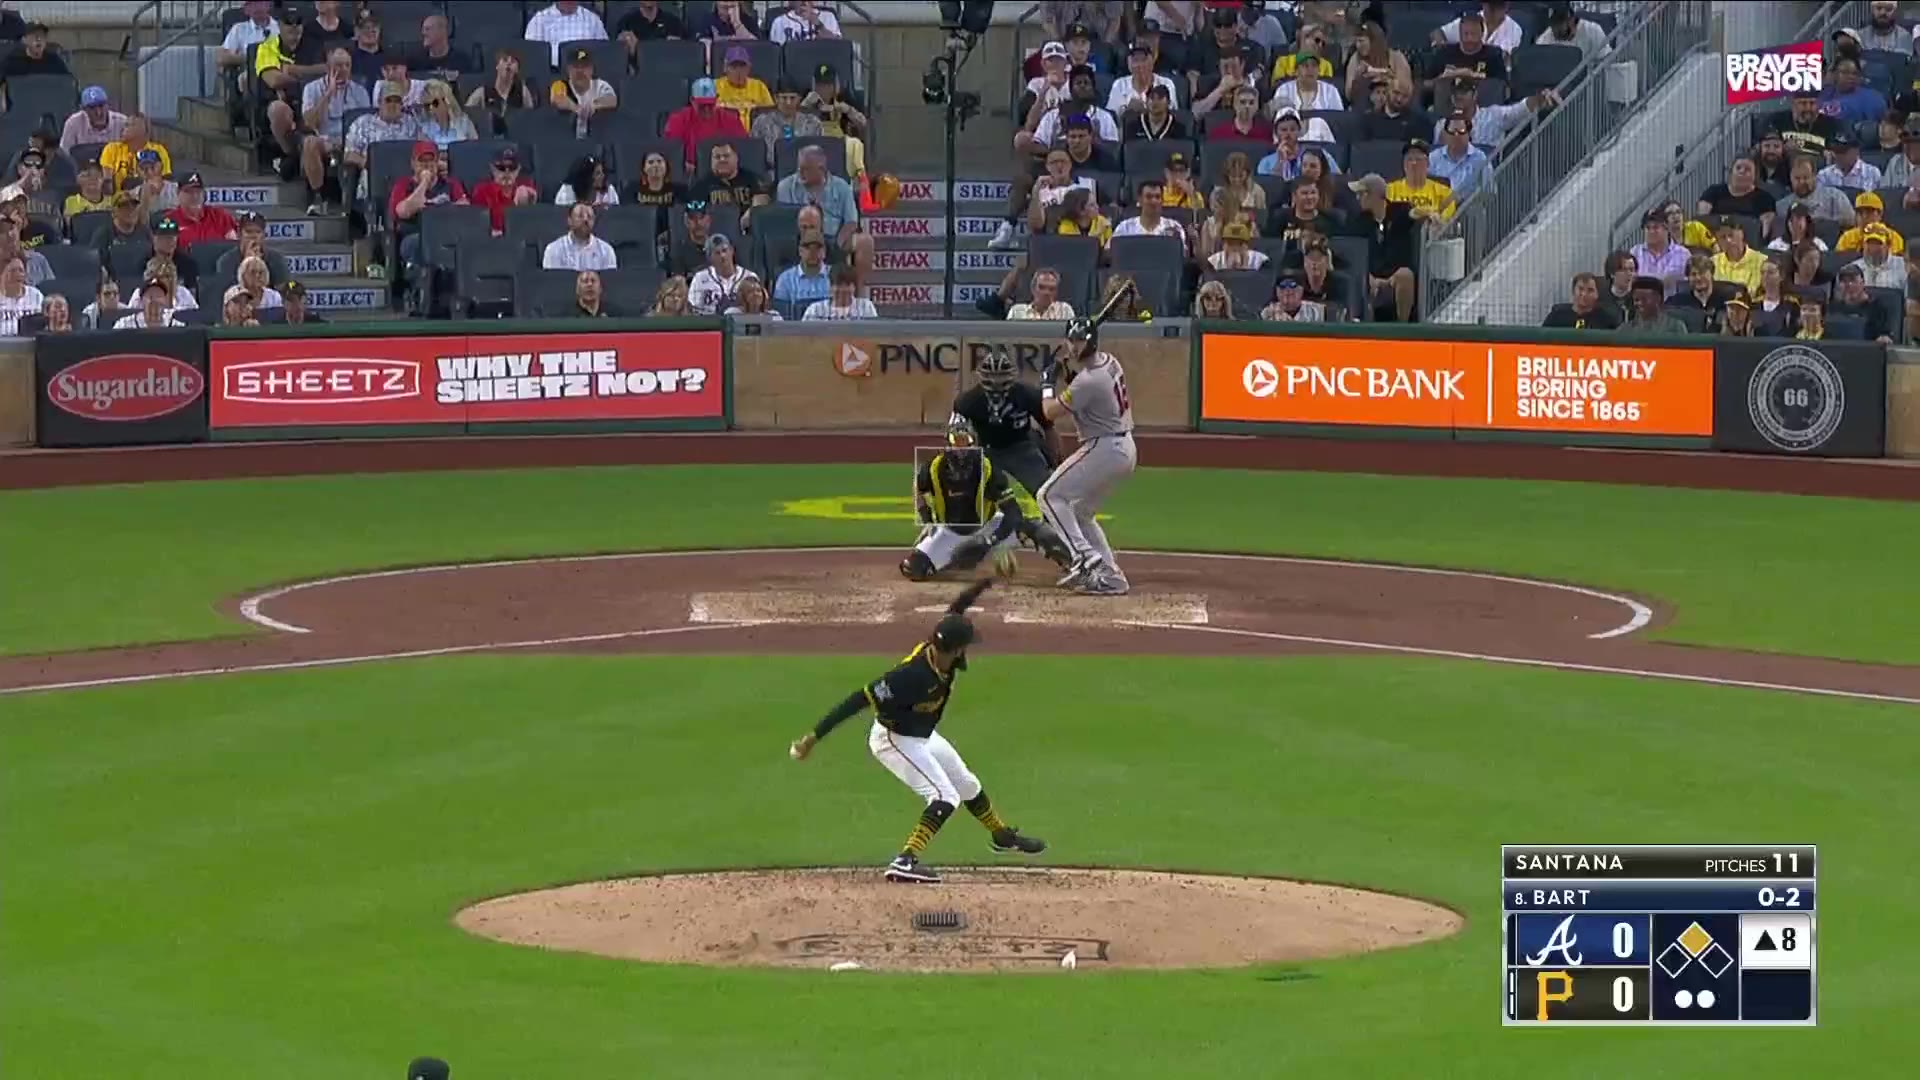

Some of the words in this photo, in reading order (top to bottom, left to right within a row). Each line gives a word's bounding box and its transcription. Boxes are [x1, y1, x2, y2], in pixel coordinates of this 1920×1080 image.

[207, 189, 269, 203] ELECT
[959, 183, 1011, 199] SELE
[958, 253, 1017, 268] SELEC
[437, 354, 532, 380] WHY
[539, 350, 617, 376] THE
[877, 343, 959, 374] PNC
[1517, 356, 1657, 381] BRILLIANTLY
[57, 367, 194, 410] Sugardale
[237, 368, 406, 395] SHEETZ
[436, 374, 592, 404] SHEETZ
[596, 368, 707, 396] NOT?
[1517, 377, 1608, 400] BORING
[1517, 397, 1586, 419] SINCE
[1589, 400, 1641, 421] 1865
[1783, 388, 1809, 408] 66
